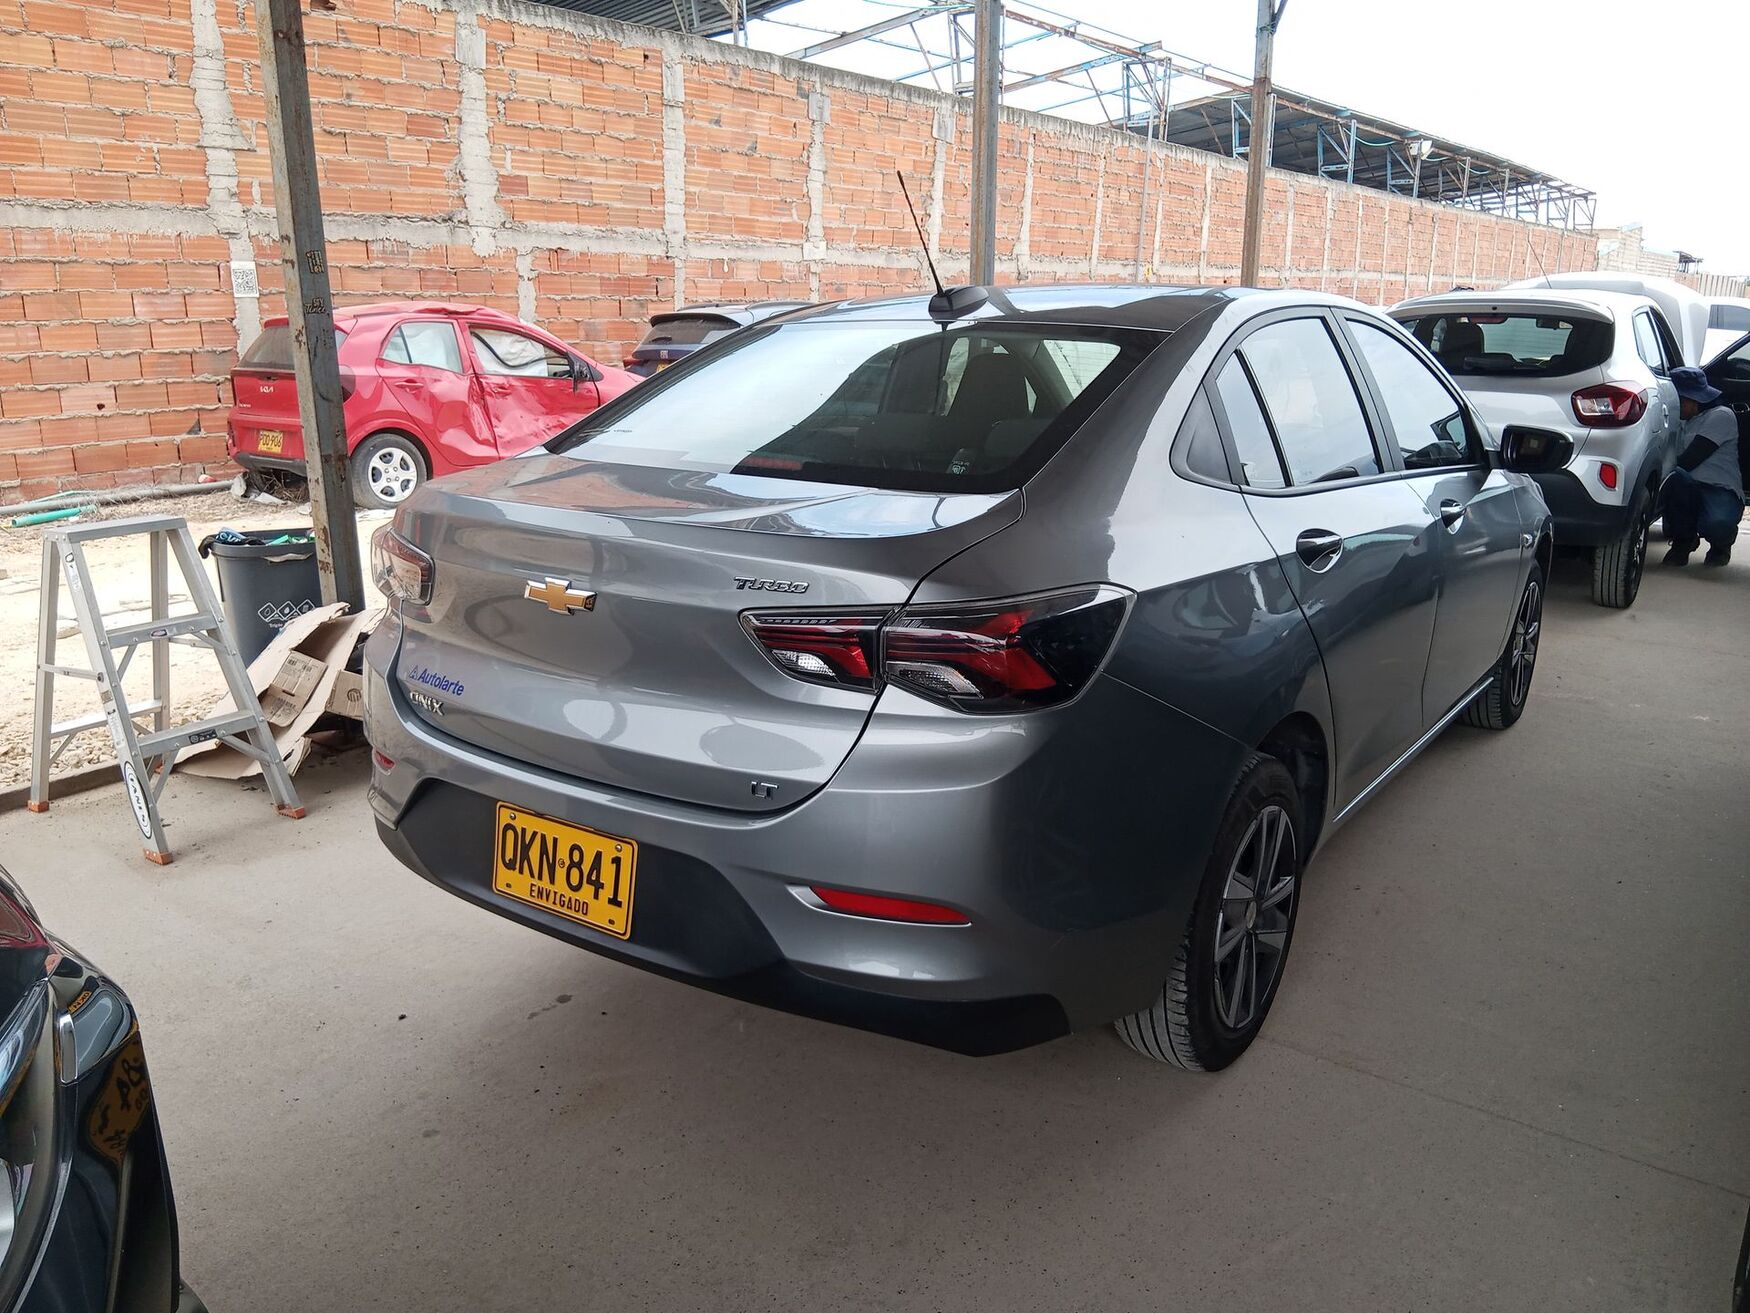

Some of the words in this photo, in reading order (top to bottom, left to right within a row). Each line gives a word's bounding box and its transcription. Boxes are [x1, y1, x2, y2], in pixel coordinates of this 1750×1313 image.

[734, 576, 809, 593] TURBO
[417, 668, 465, 696] Autolarte
[410, 691, 445, 716] ONIX
[751, 781, 779, 800] LT
[529, 883, 589, 916] ENVIGADO
